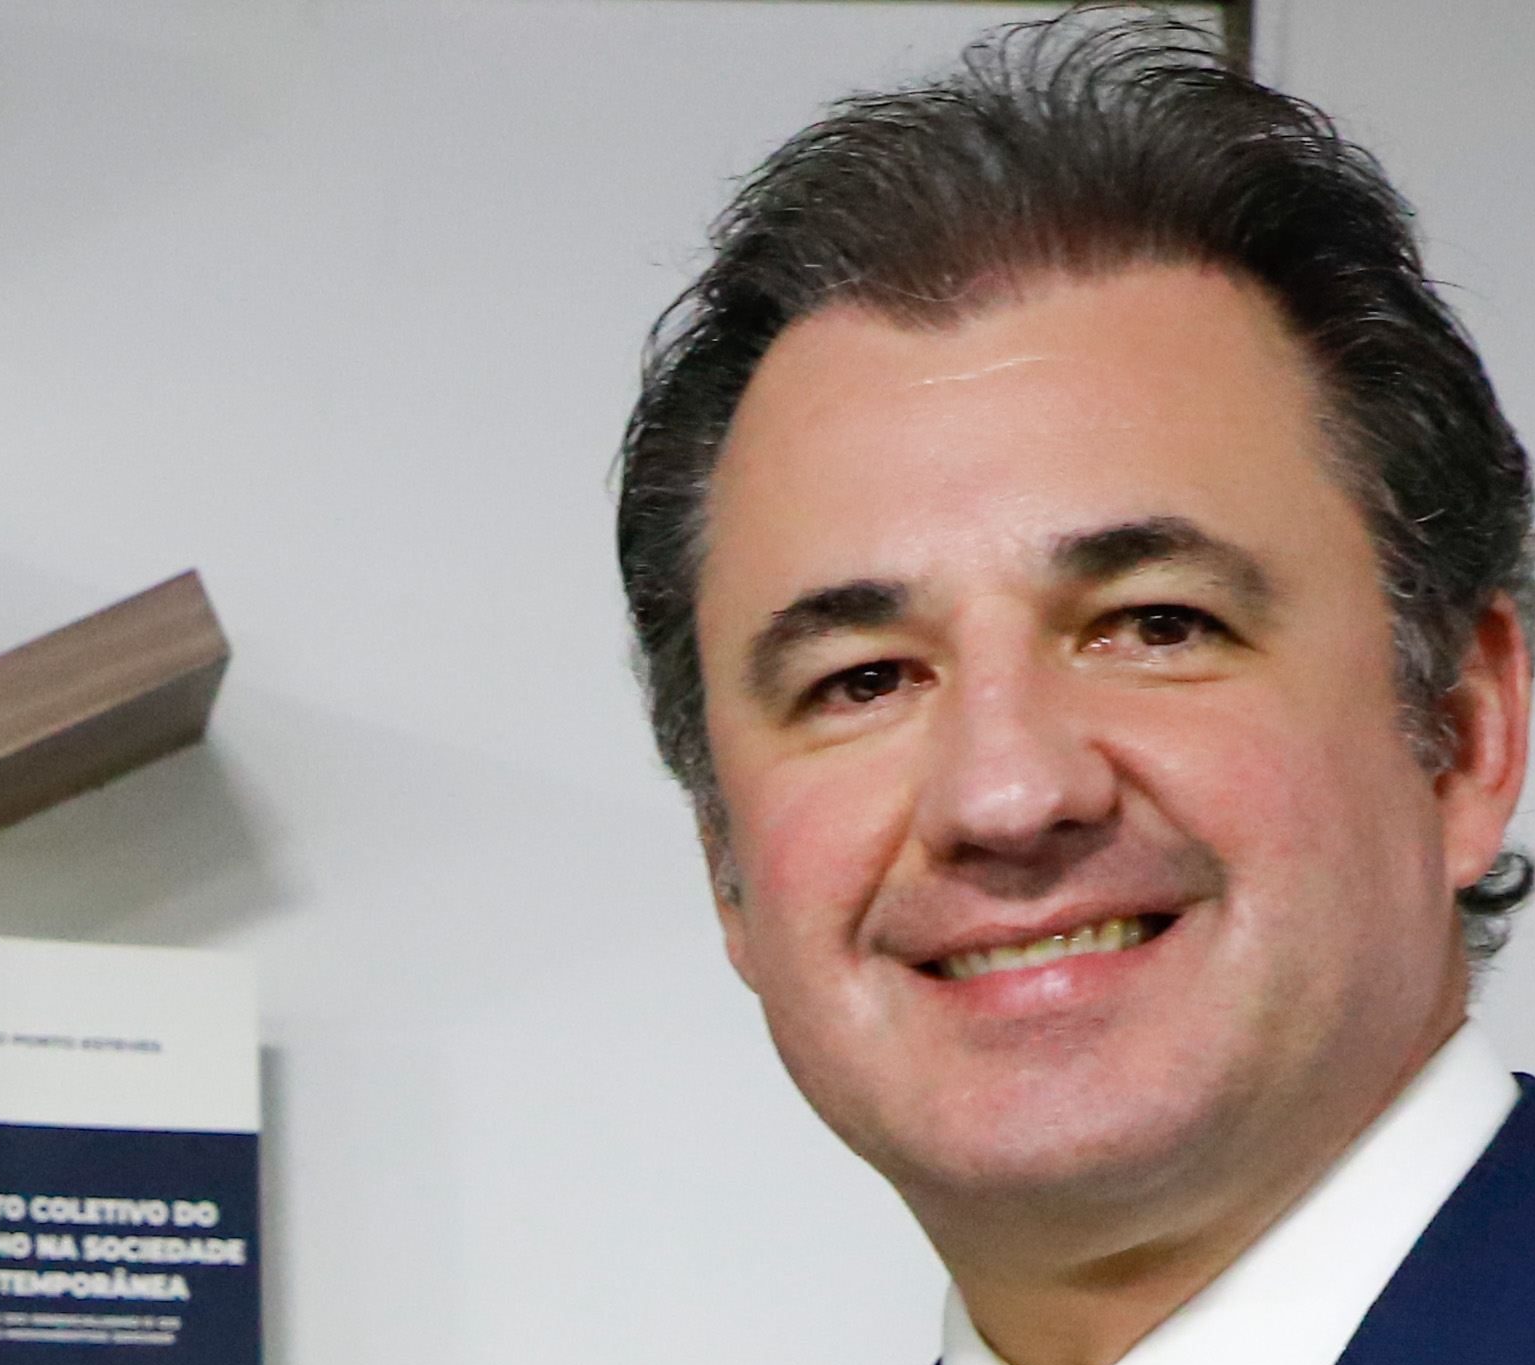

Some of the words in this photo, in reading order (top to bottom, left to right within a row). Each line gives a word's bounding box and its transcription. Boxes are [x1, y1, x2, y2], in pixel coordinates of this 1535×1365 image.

[29, 1196, 170, 1227] COLETIVO
[172, 1200, 220, 1229] DO
[35, 1233, 79, 1261] NA
[81, 1234, 247, 1266] SOCIEDADE
